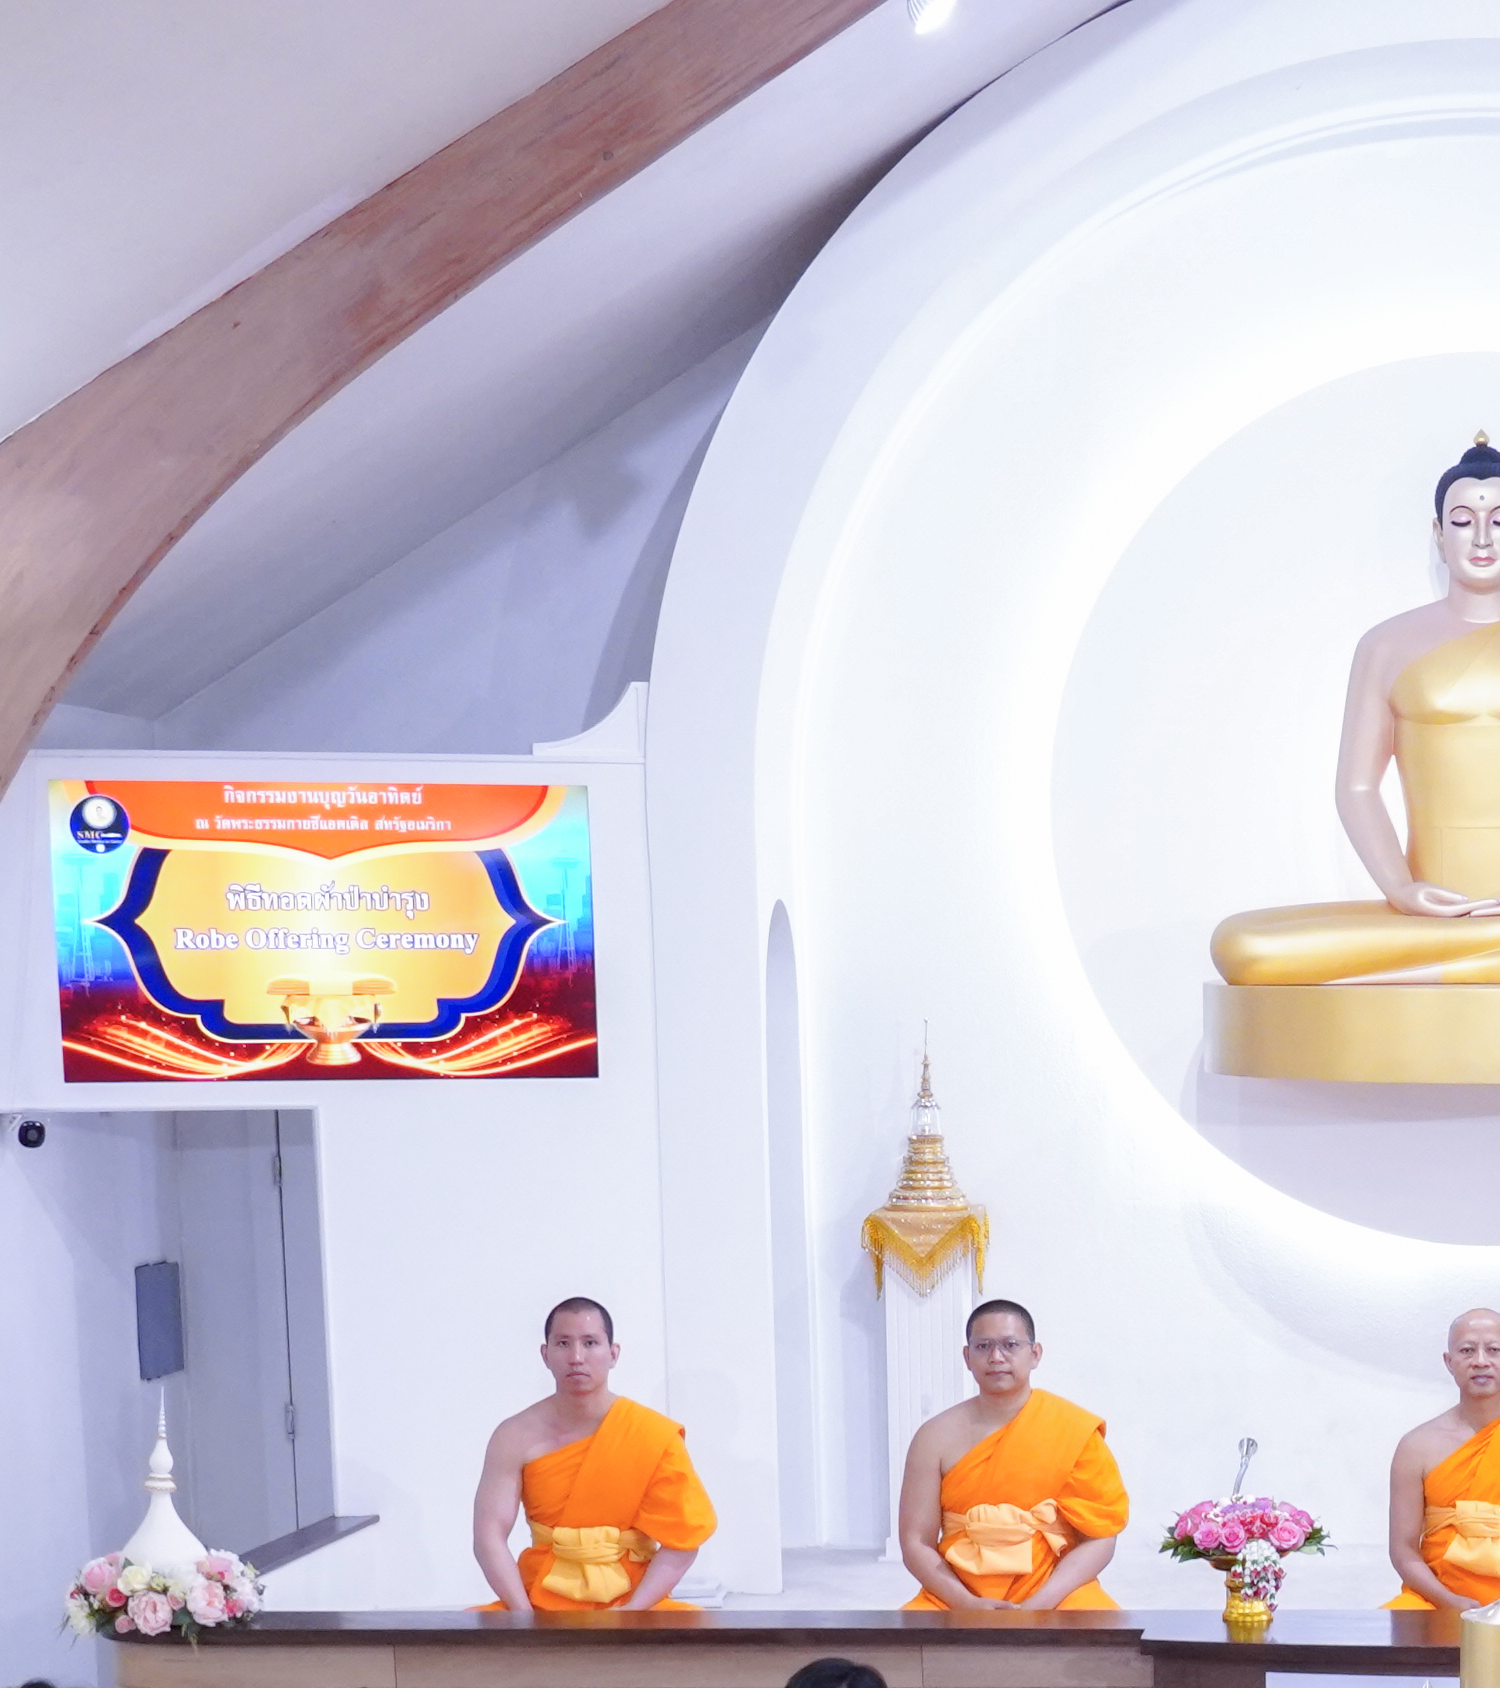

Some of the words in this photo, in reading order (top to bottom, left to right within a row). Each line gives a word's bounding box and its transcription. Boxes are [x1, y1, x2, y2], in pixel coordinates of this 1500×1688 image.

[223, 784, 424, 810] กิจกรรมงานบุญวันอาทิตย์
[226, 880, 430, 919] พิธีทอดผ้าป่าบำรุง
[174, 928, 239, 949] Robe
[245, 928, 350, 954] Offering
[355, 928, 479, 954] Ceremony
